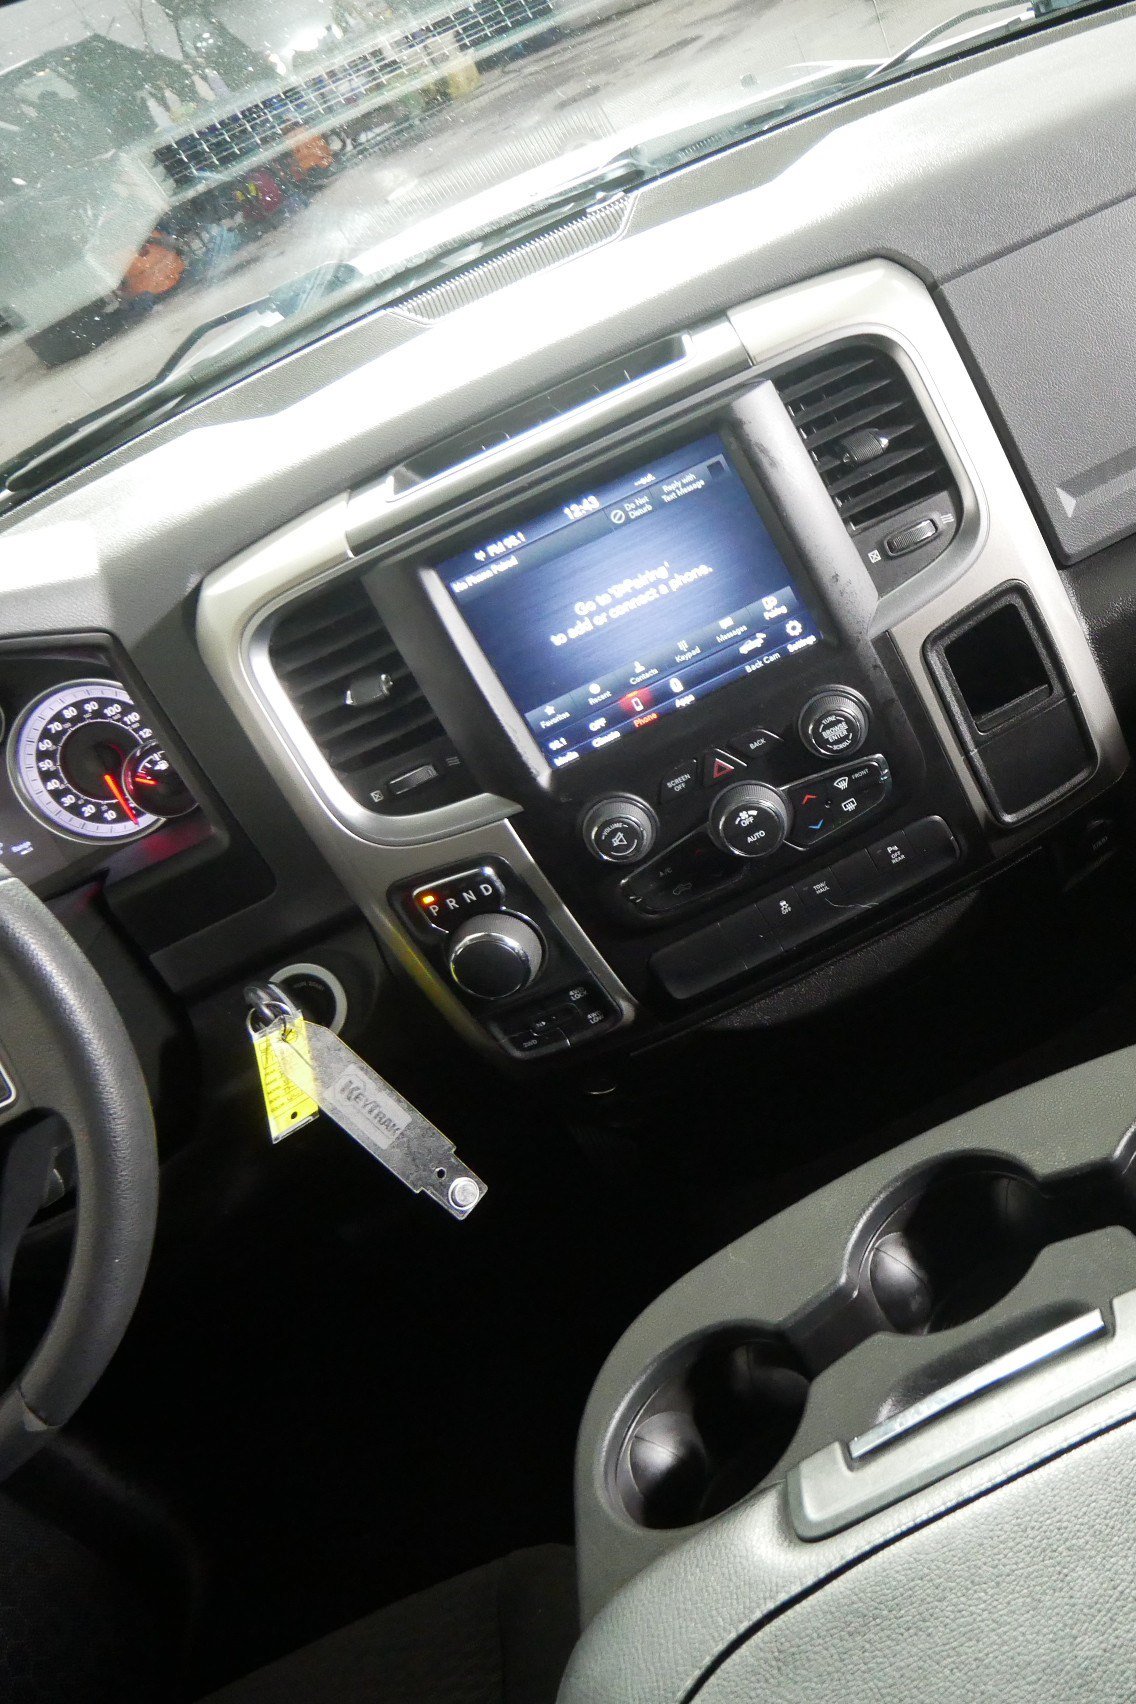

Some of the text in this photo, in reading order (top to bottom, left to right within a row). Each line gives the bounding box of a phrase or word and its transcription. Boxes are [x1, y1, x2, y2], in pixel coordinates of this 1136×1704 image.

[662, 472, 696, 493] Reply with
[661, 479, 705, 503] Text Message
[564, 495, 600, 520] 12:43
[624, 496, 650, 511] Do Not
[628, 504, 653, 519] Disturb
[551, 564, 714, 647] to add or connect a phone.
[574, 600, 597, 616] Go
[595, 592, 612, 607] to
[716, 625, 748, 643] Messages
[674, 645, 701, 663] Keypad
[745, 652, 781, 673] Back Cam
[629, 667, 659, 685] Contacts
[588, 690, 613, 706] Recent
[62, 706, 78, 719] 80
[83, 701, 99, 713] 90
[103, 703, 122, 717] 100
[123, 712, 141, 725] 110
[540, 711, 571, 729] Favorites
[633, 712, 658, 728] Phone
[821, 715, 837, 725] TUNE
[47, 721, 63, 734] 70
[821, 721, 849, 739] BROWSE
[828, 729, 848, 743] ENTER
[38, 738, 52, 751] 60
[749, 737, 766, 750] BACK
[832, 739, 852, 751] SCROLL
[38, 758, 54, 771] 50
[851, 768, 869, 779] FRONT
[46, 778, 60, 791] 40
[666, 773, 691, 788] SCREEN
[673, 783, 686, 792] OFF
[61, 794, 76, 807] 30
[81, 804, 96, 817] 20
[103, 810, 117, 821] 10
[740, 816, 755, 827] OFF
[603, 822, 623, 836] VOLUME
[746, 830, 766, 843] AUTO
[890, 850, 901, 859] OFF
[891, 854, 906, 865] REAR
[815, 885, 830, 895] HAUL
[429, 883, 493, 917] P R N D
[781, 906, 792, 915] OFF
